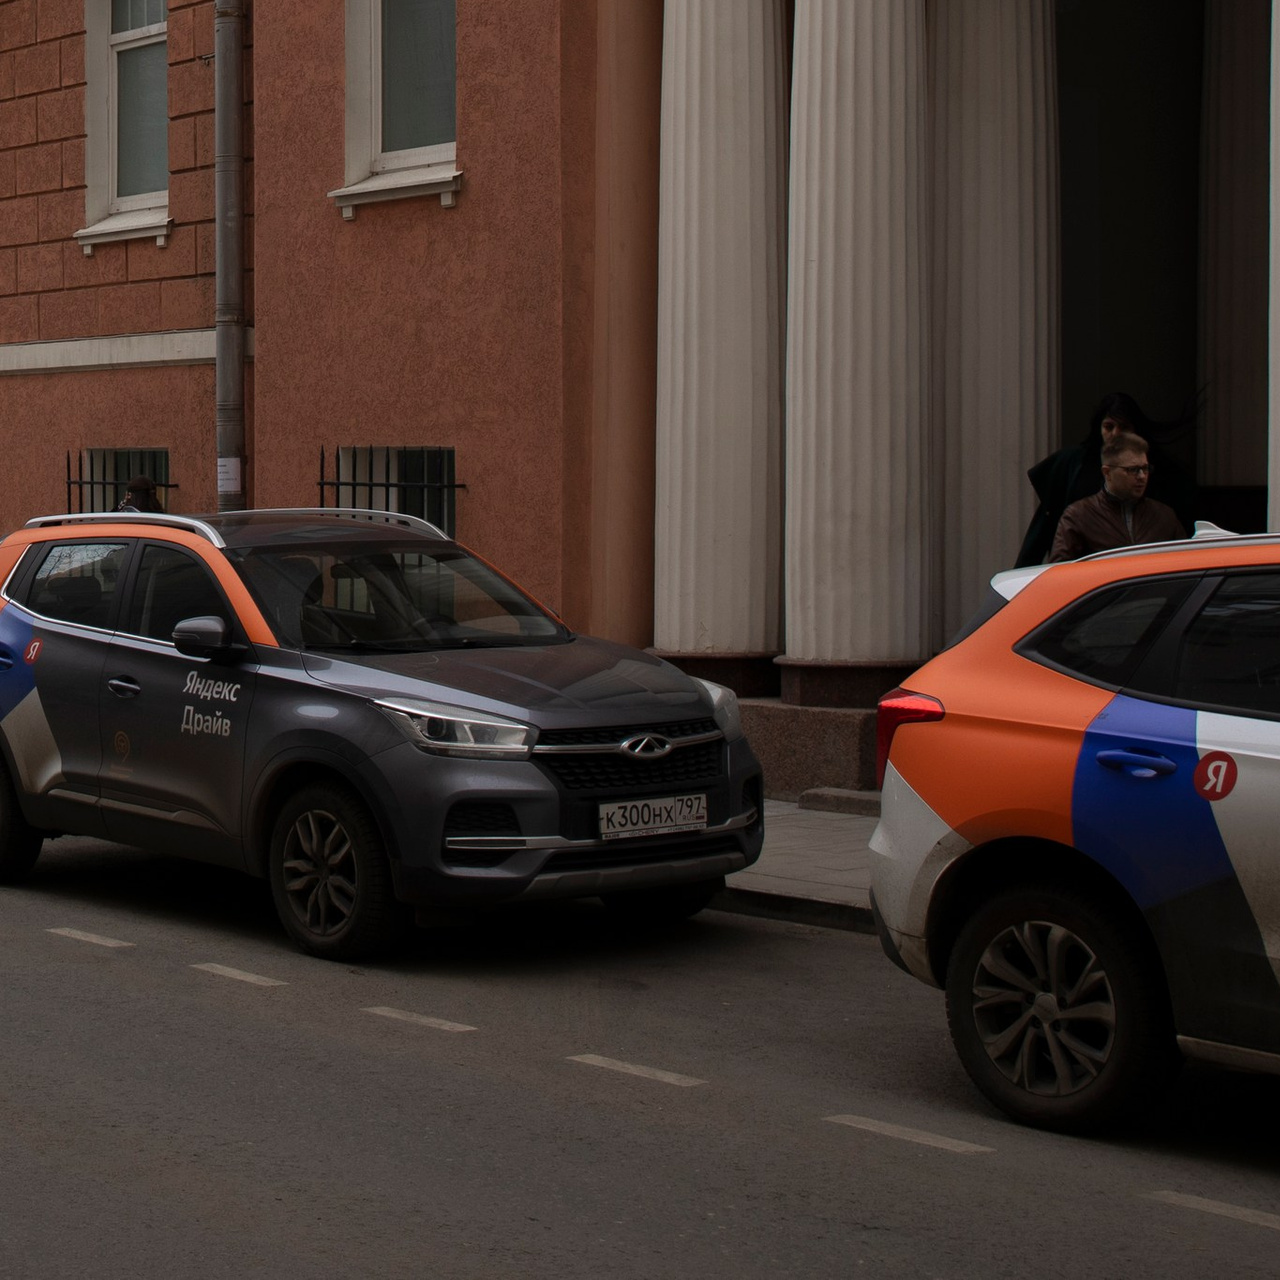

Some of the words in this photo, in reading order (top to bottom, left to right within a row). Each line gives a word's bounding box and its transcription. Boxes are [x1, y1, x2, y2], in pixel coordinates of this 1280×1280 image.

[26, 641, 40, 660] Я
[182, 670, 241, 702] Яндекс
[181, 704, 231, 736] Драйв
[1202, 760, 1228, 793] Я
[676, 796, 702, 815] 797
